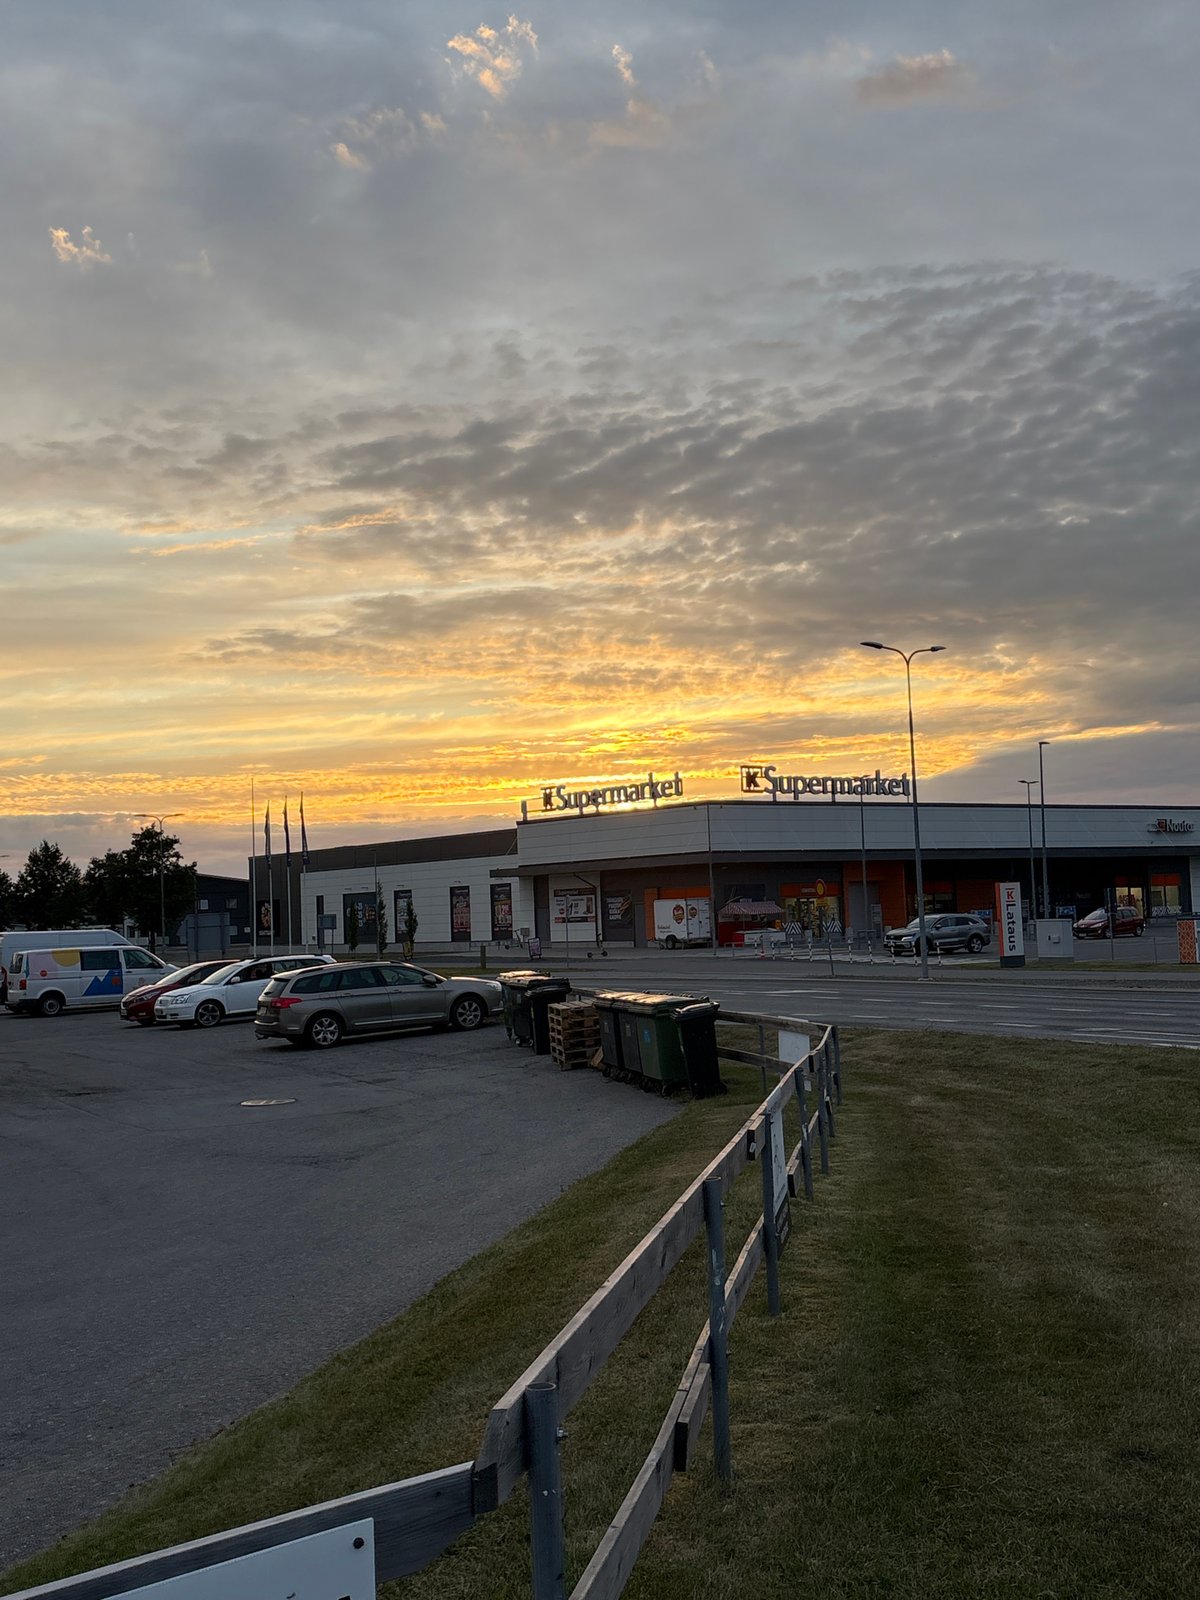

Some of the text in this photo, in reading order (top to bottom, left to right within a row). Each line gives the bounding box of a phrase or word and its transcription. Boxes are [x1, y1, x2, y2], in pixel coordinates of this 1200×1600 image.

[556, 772, 684, 812] Supermarket
[764, 765, 911, 801] Supermarket
[1005, 903, 1017, 952] Lataus
